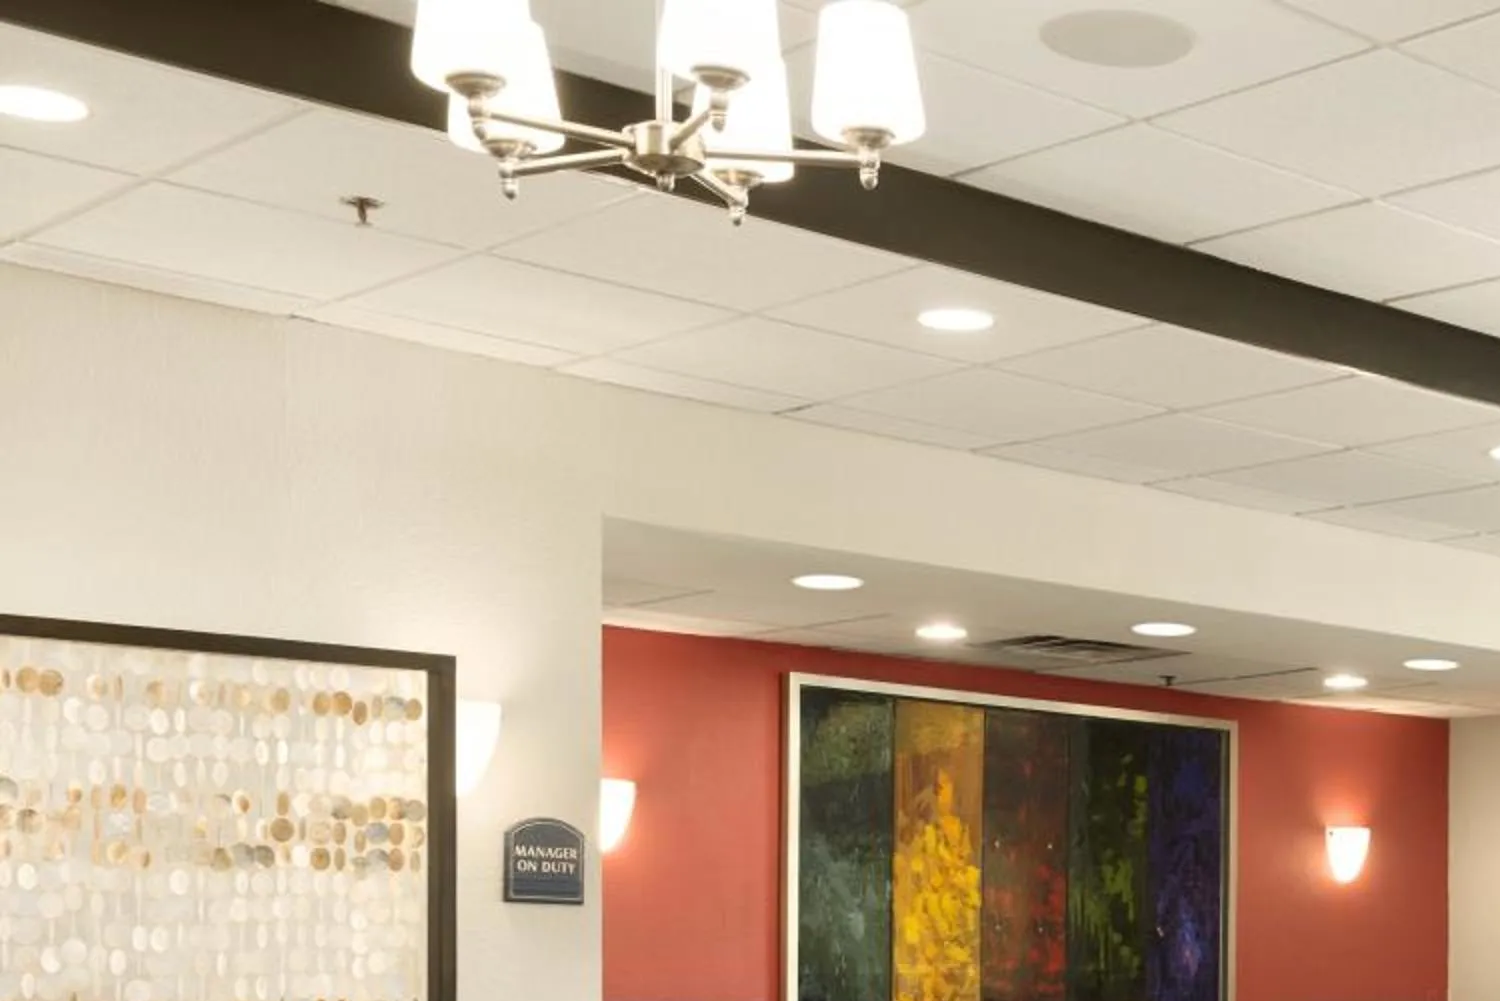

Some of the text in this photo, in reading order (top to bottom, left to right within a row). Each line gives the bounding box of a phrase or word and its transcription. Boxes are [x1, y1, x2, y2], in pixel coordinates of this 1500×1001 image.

[515, 845, 577, 859] MANAGER
[517, 859, 576, 875] ON DUTY
